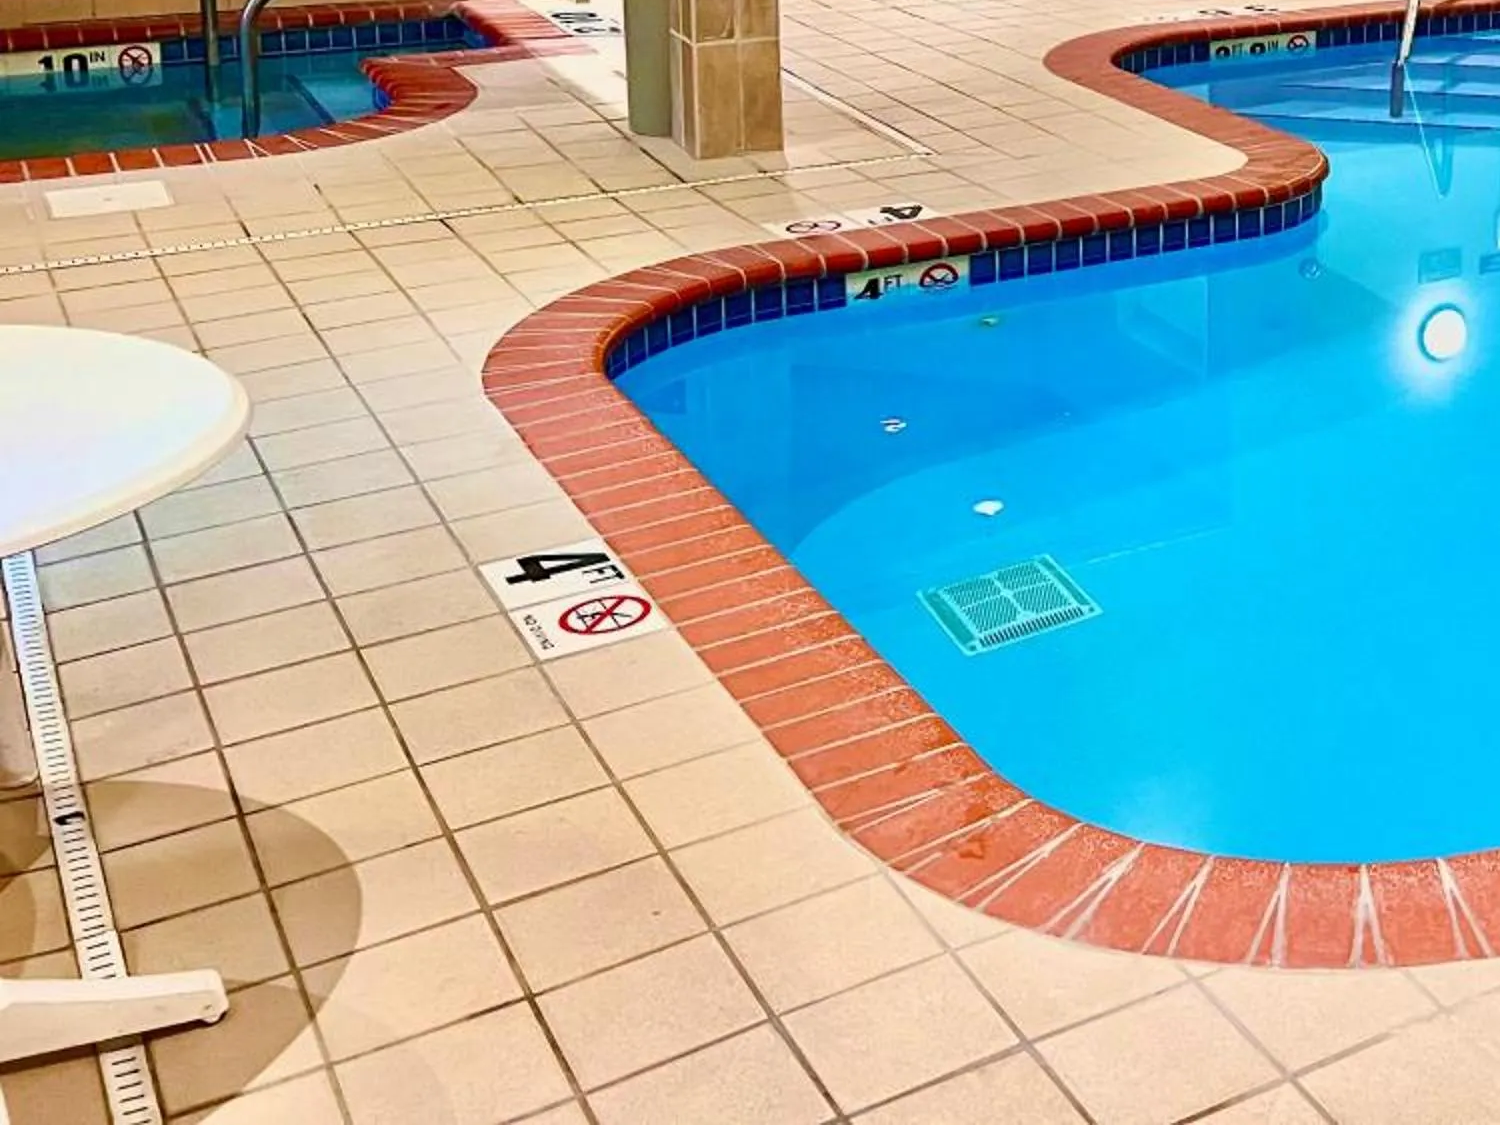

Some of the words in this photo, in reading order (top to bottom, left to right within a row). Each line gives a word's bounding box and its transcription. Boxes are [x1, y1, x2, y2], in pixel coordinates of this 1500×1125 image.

[854, 278, 884, 300] 4
[884, 274, 904, 290] FT
[506, 553, 611, 585] 4
